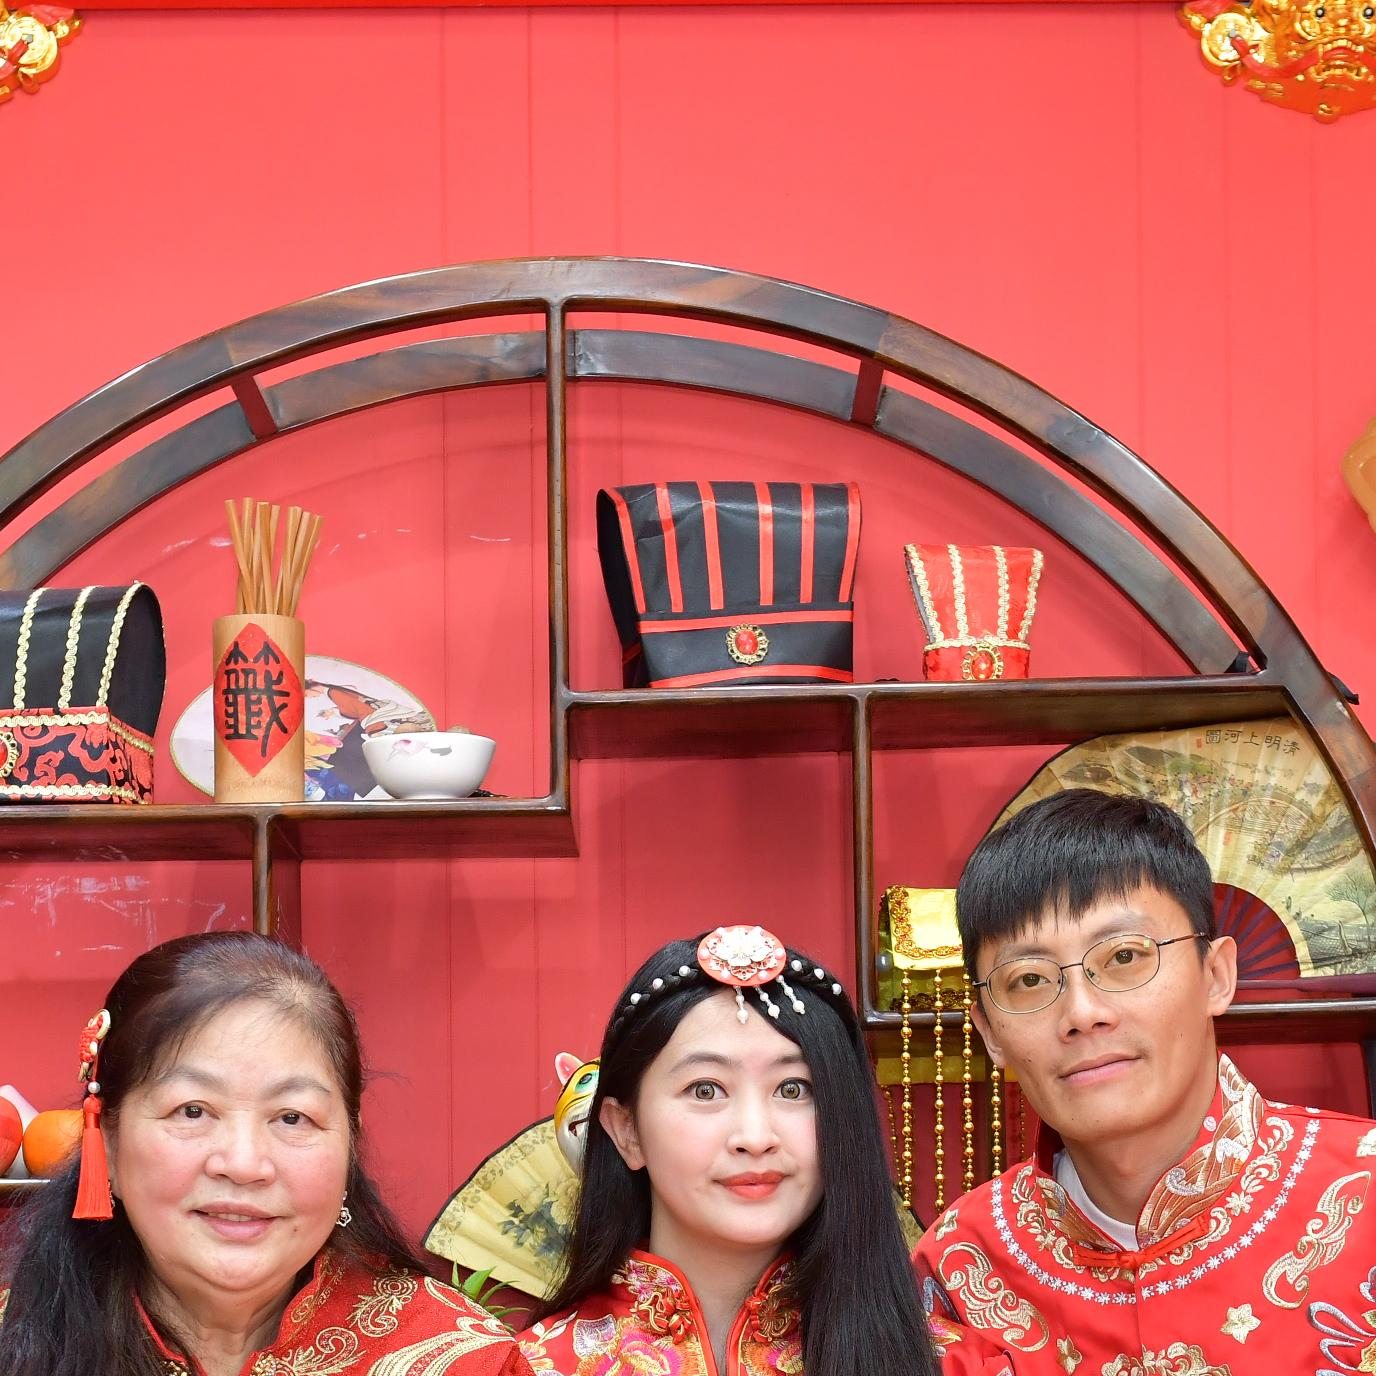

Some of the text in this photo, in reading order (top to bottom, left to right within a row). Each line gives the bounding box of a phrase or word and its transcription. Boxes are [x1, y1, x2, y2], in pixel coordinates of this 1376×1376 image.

[1205, 729, 1301, 757] 清明上河圖
